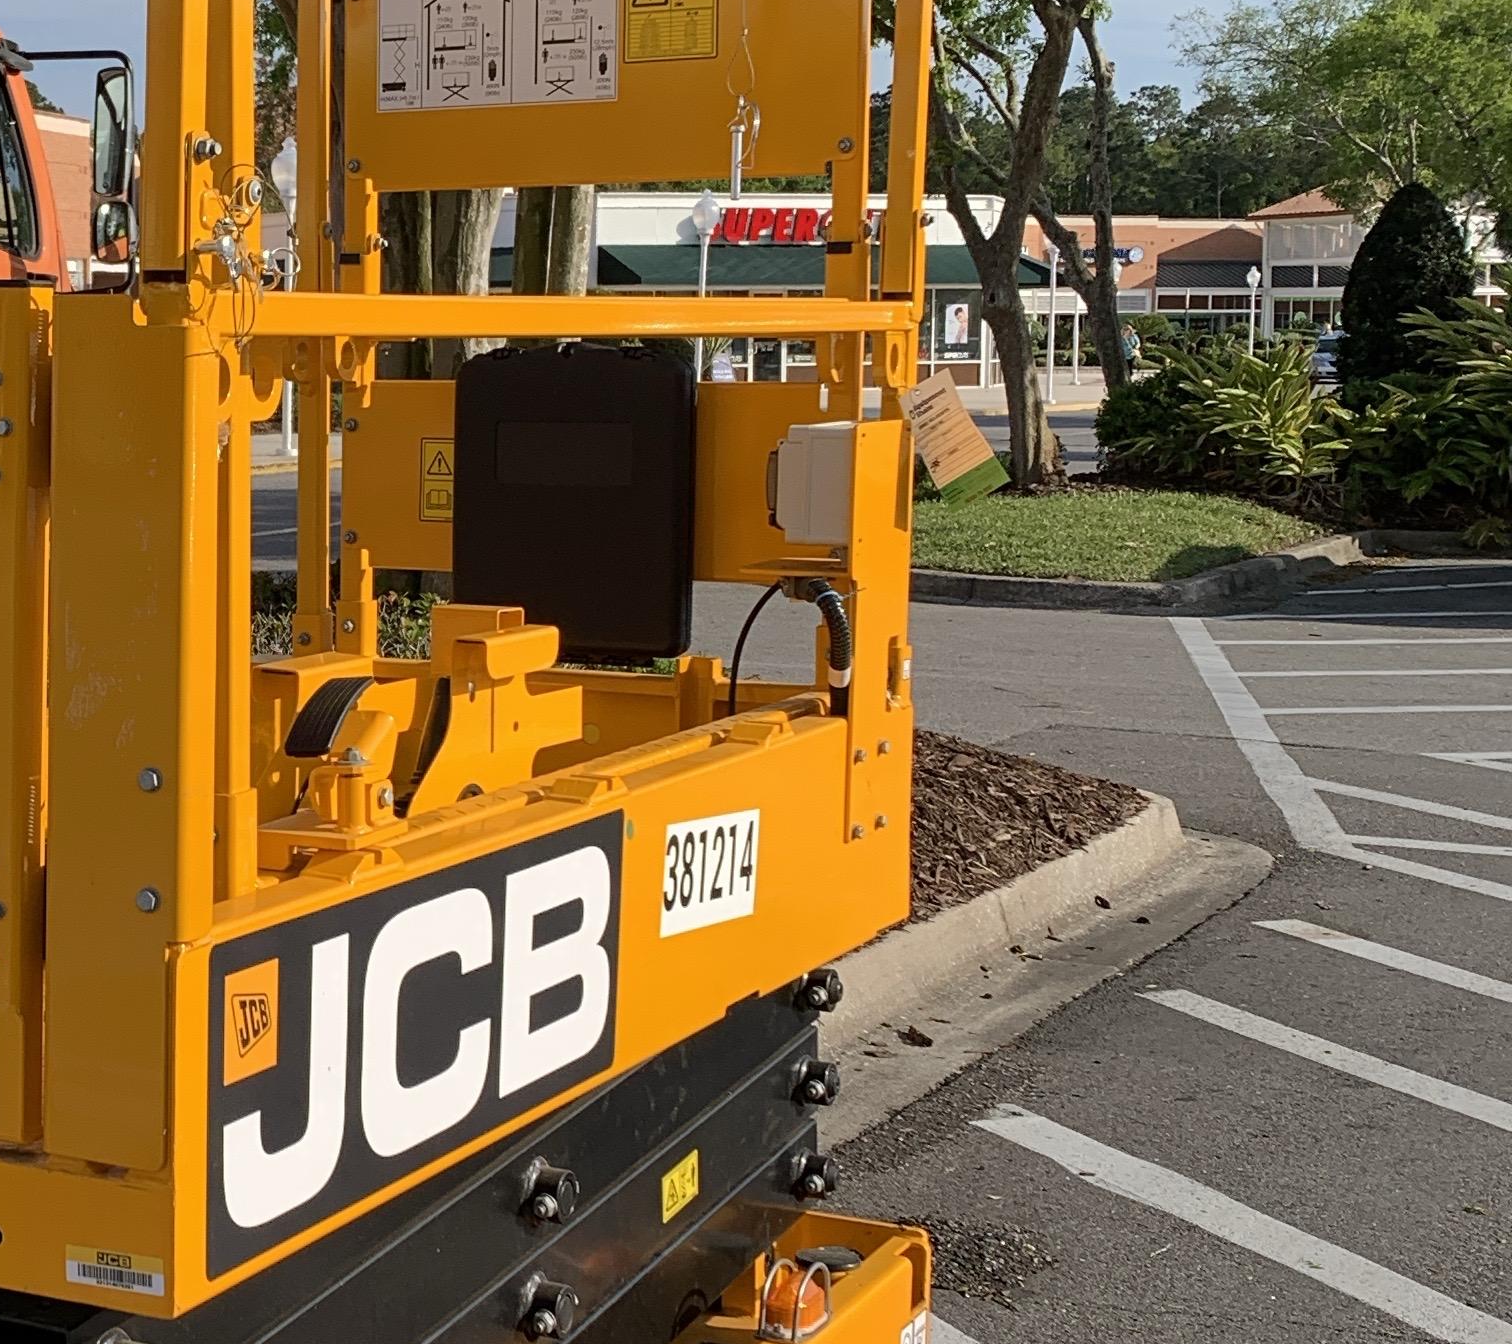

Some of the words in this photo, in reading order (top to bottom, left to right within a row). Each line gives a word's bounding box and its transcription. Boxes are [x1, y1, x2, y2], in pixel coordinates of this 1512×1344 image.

[663, 819, 753, 912] 381214
[222, 845, 611, 1229] JCB
[238, 993, 270, 1055] JCB
[98, 1252, 130, 1268] JCB
